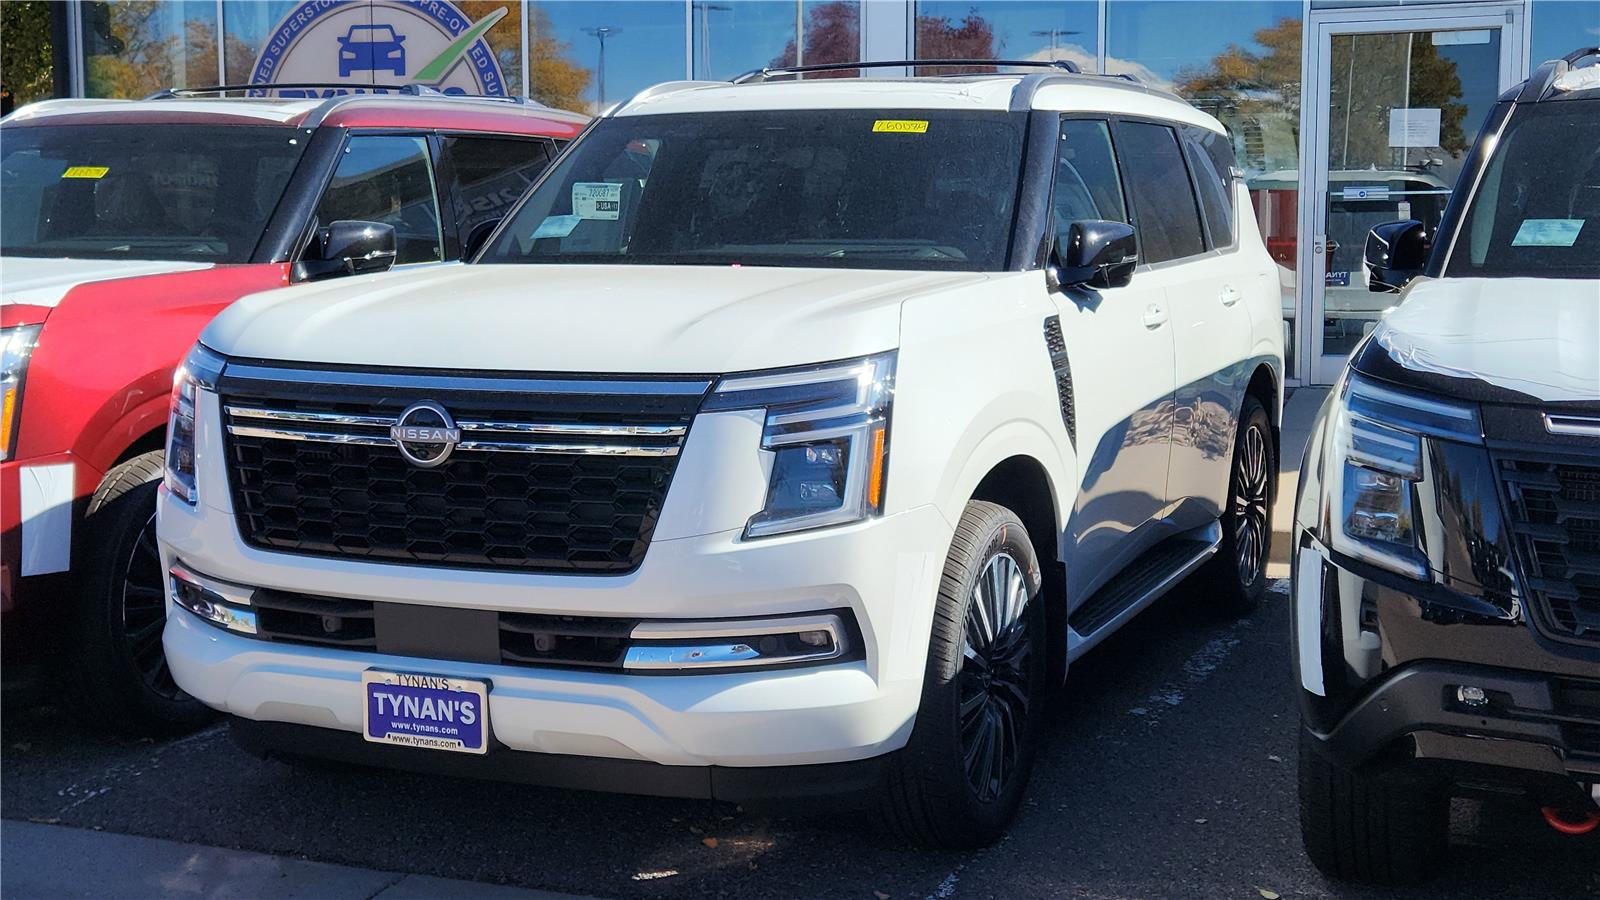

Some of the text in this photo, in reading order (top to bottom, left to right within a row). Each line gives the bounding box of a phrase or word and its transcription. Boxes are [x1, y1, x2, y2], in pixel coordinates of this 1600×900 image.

[601, 202, 611, 210] USA
[392, 428, 457, 440] NISSAN
[396, 674, 449, 690] TYNAN'S
[373, 692, 476, 725] TYNAN'S
[391, 721, 458, 735] www.tynans.com
[392, 735, 457, 749] www.tynans.com
